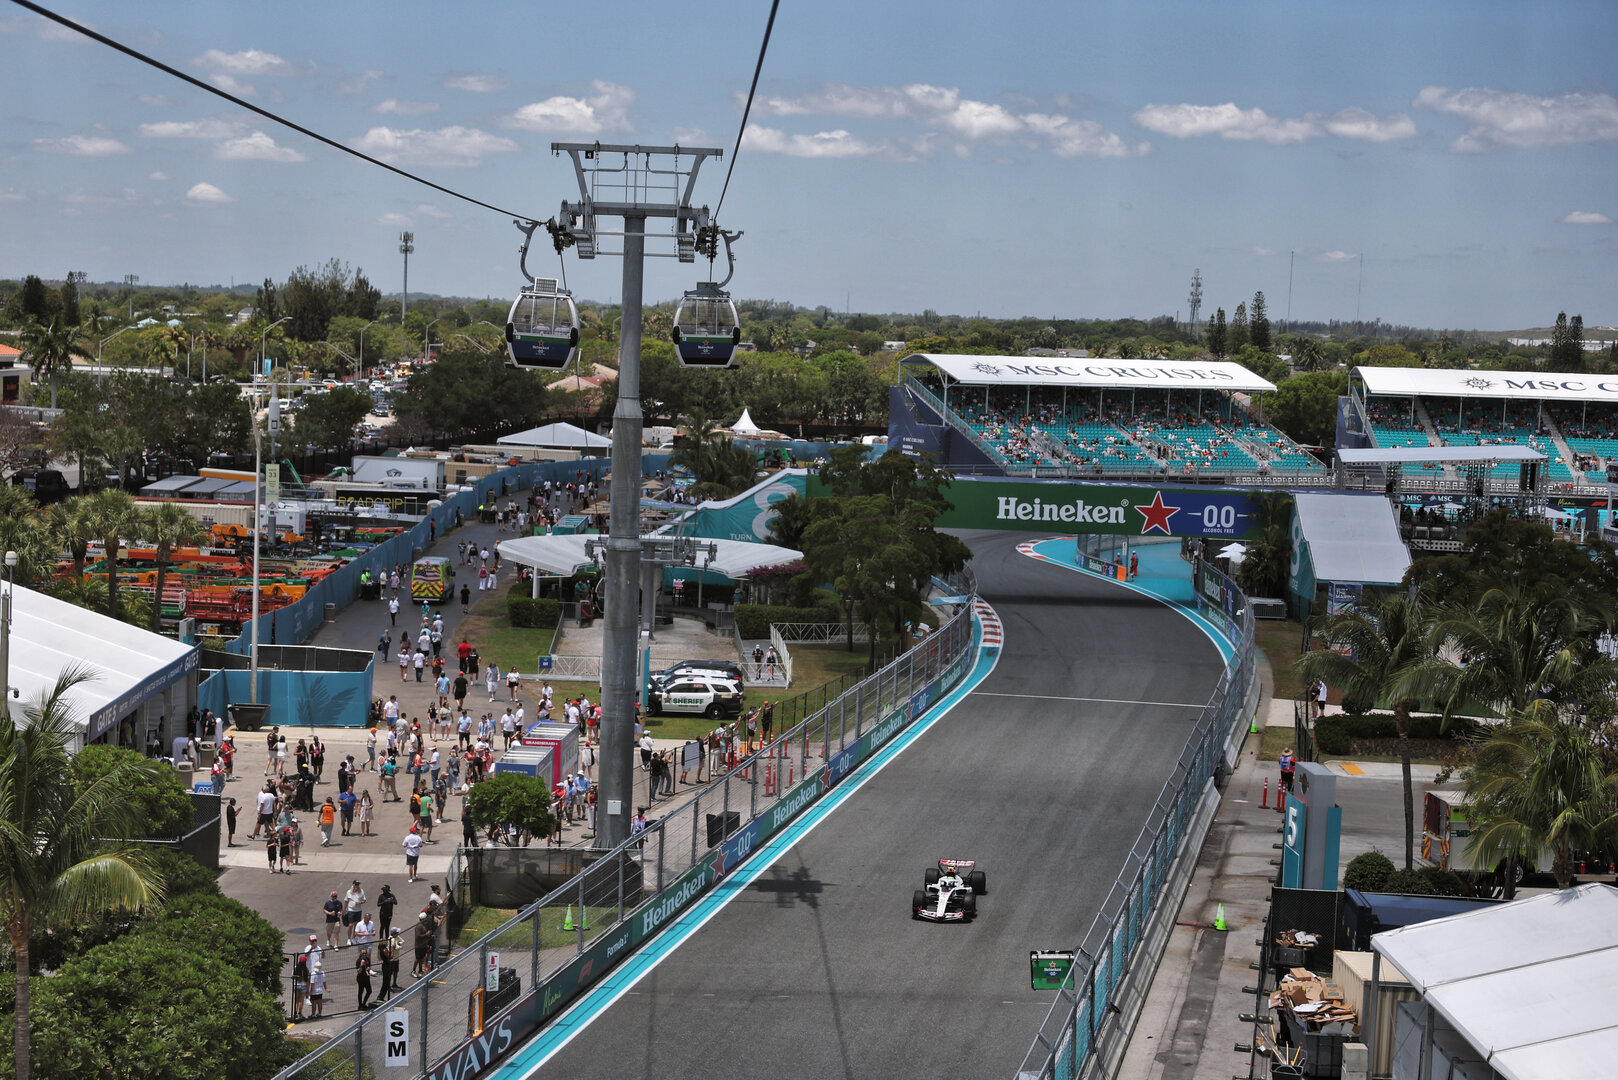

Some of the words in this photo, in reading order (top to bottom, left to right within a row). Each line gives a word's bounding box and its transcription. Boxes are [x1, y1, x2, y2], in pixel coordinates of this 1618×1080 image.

[1007, 364, 1080, 376] MSC
[1084, 366, 1234, 380] CRUISES
[1504, 379, 1587, 392] MSC
[996, 496, 1126, 524] Heineken
[730, 534, 752, 542] TURN
[184, 651, 196, 672] GATE
[98, 706, 112, 732] GATE
[870, 714, 902, 750] Heineken
[772, 781, 816, 829] Heineken
[1287, 806, 1298, 847] 5
[642, 870, 706, 936] Heineken
[606, 938, 624, 958] Formula
[542, 984, 562, 1016] Miami
[390, 1021, 404, 1038] S
[388, 1041, 406, 1058] M
[428, 1014, 512, 1080] WAYS
